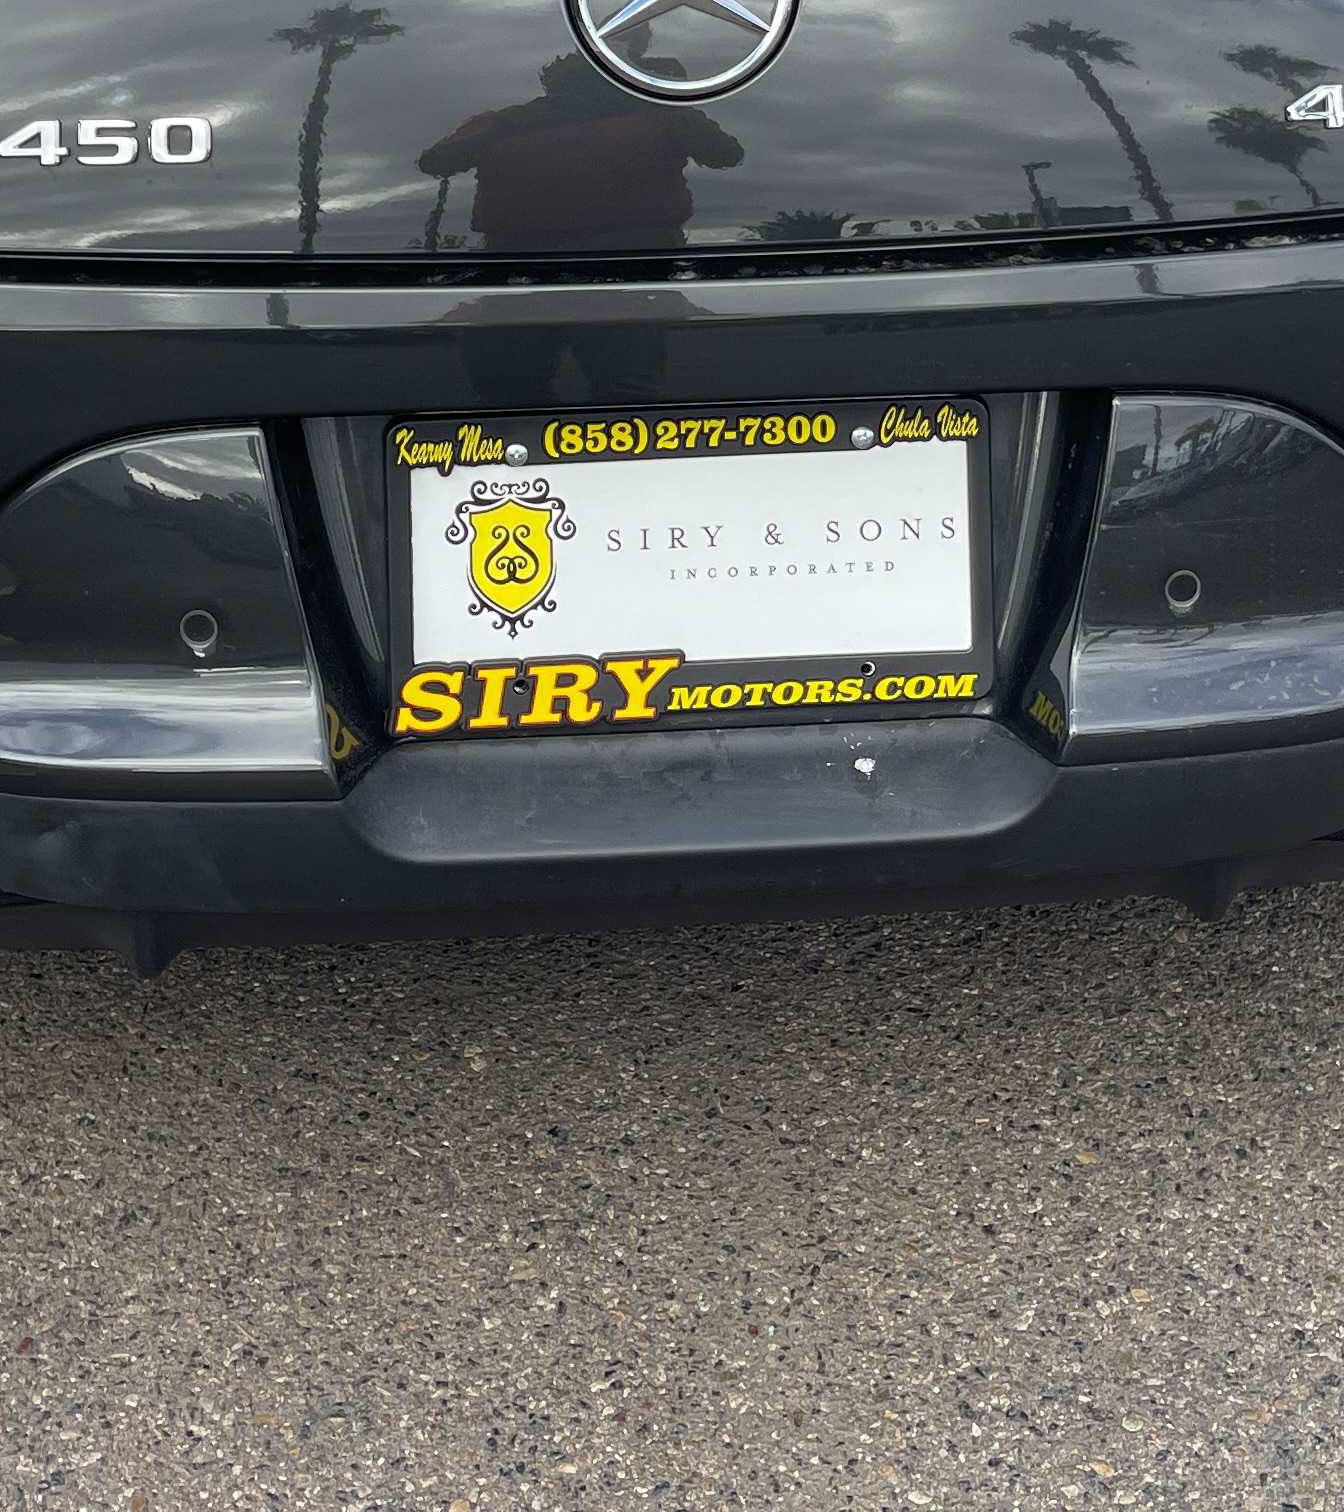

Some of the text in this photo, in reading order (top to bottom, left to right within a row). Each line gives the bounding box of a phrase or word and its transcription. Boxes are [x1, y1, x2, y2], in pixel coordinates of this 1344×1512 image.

[544, 414, 836, 459] (858) 277-7300
[880, 405, 980, 444] Chula Vista
[396, 423, 505, 472] Kearny Mesa
[606, 517, 956, 552] SIRY & SONS
[669, 560, 896, 581] INCORPORATED
